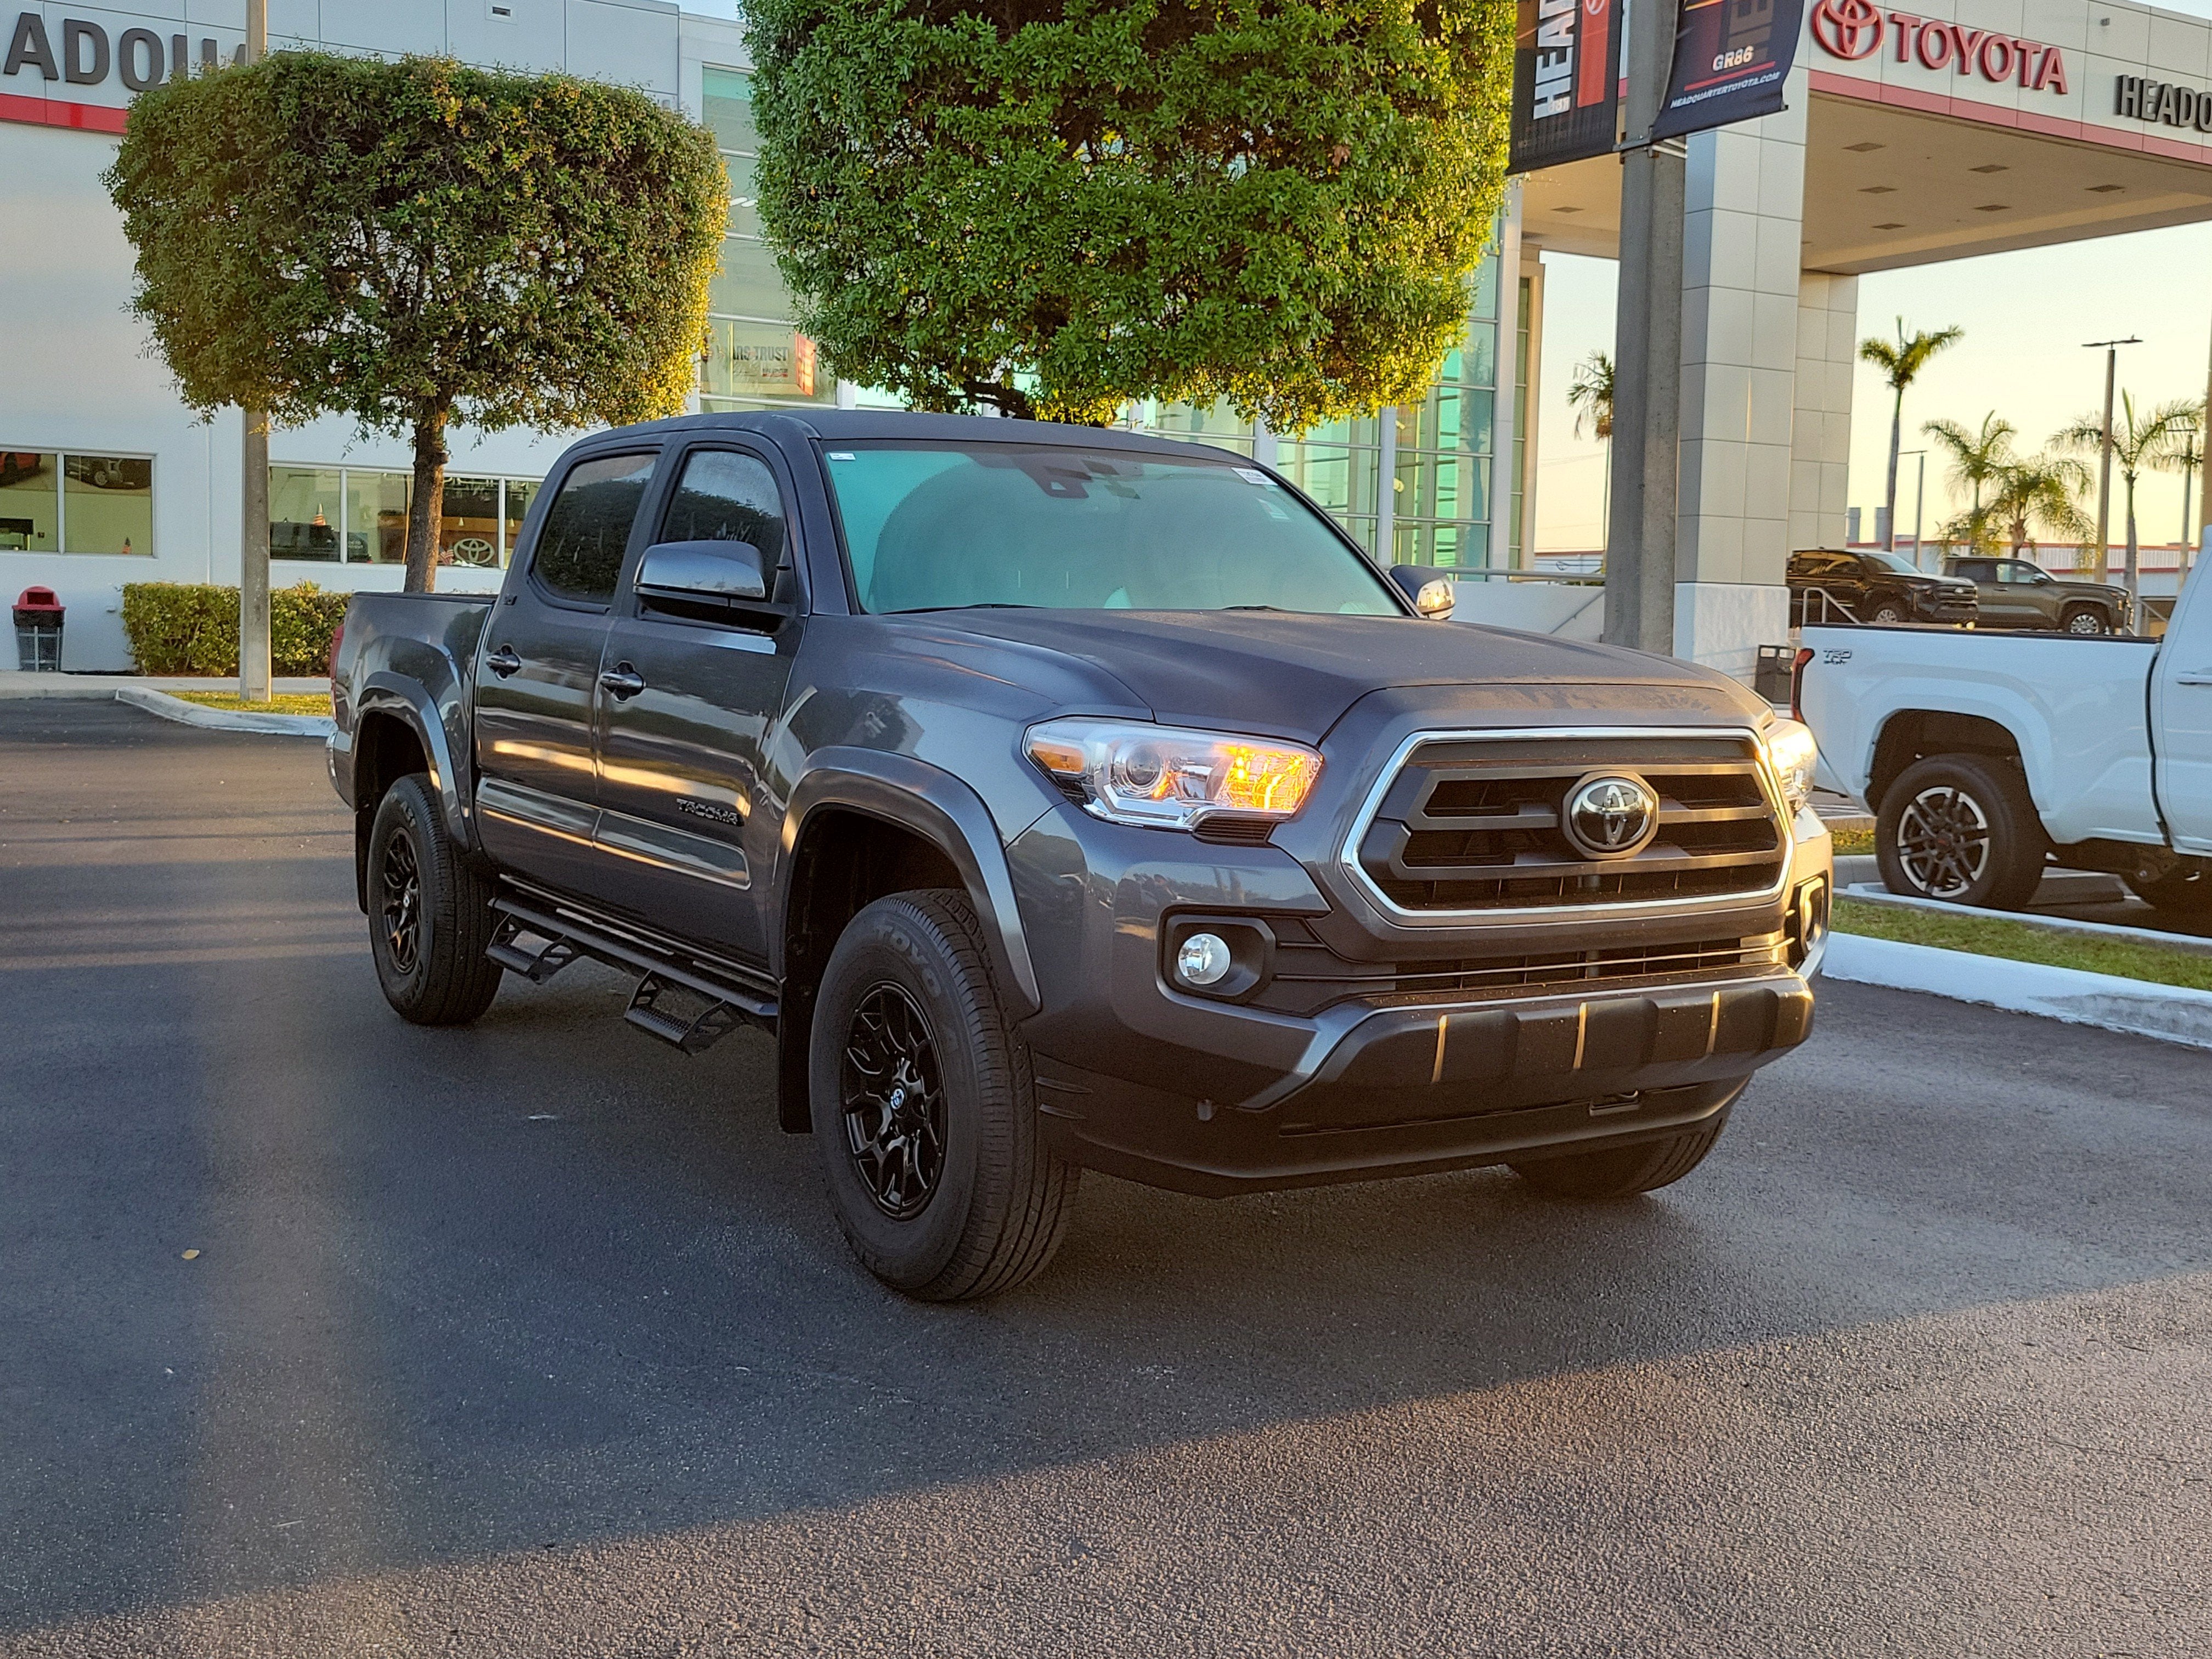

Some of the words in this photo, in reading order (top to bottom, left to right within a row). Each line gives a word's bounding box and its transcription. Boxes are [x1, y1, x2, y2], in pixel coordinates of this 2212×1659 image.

[1712, 45, 1754, 71] GR86
[1889, 13, 2068, 95] TOYOTA
[1670, 71, 1781, 109] HEADQUARTERTOYOTA.COM
[754, 346, 789, 362] TRUST
[676, 798, 738, 826] TACOMA
[874, 922, 942, 997] TOYO
